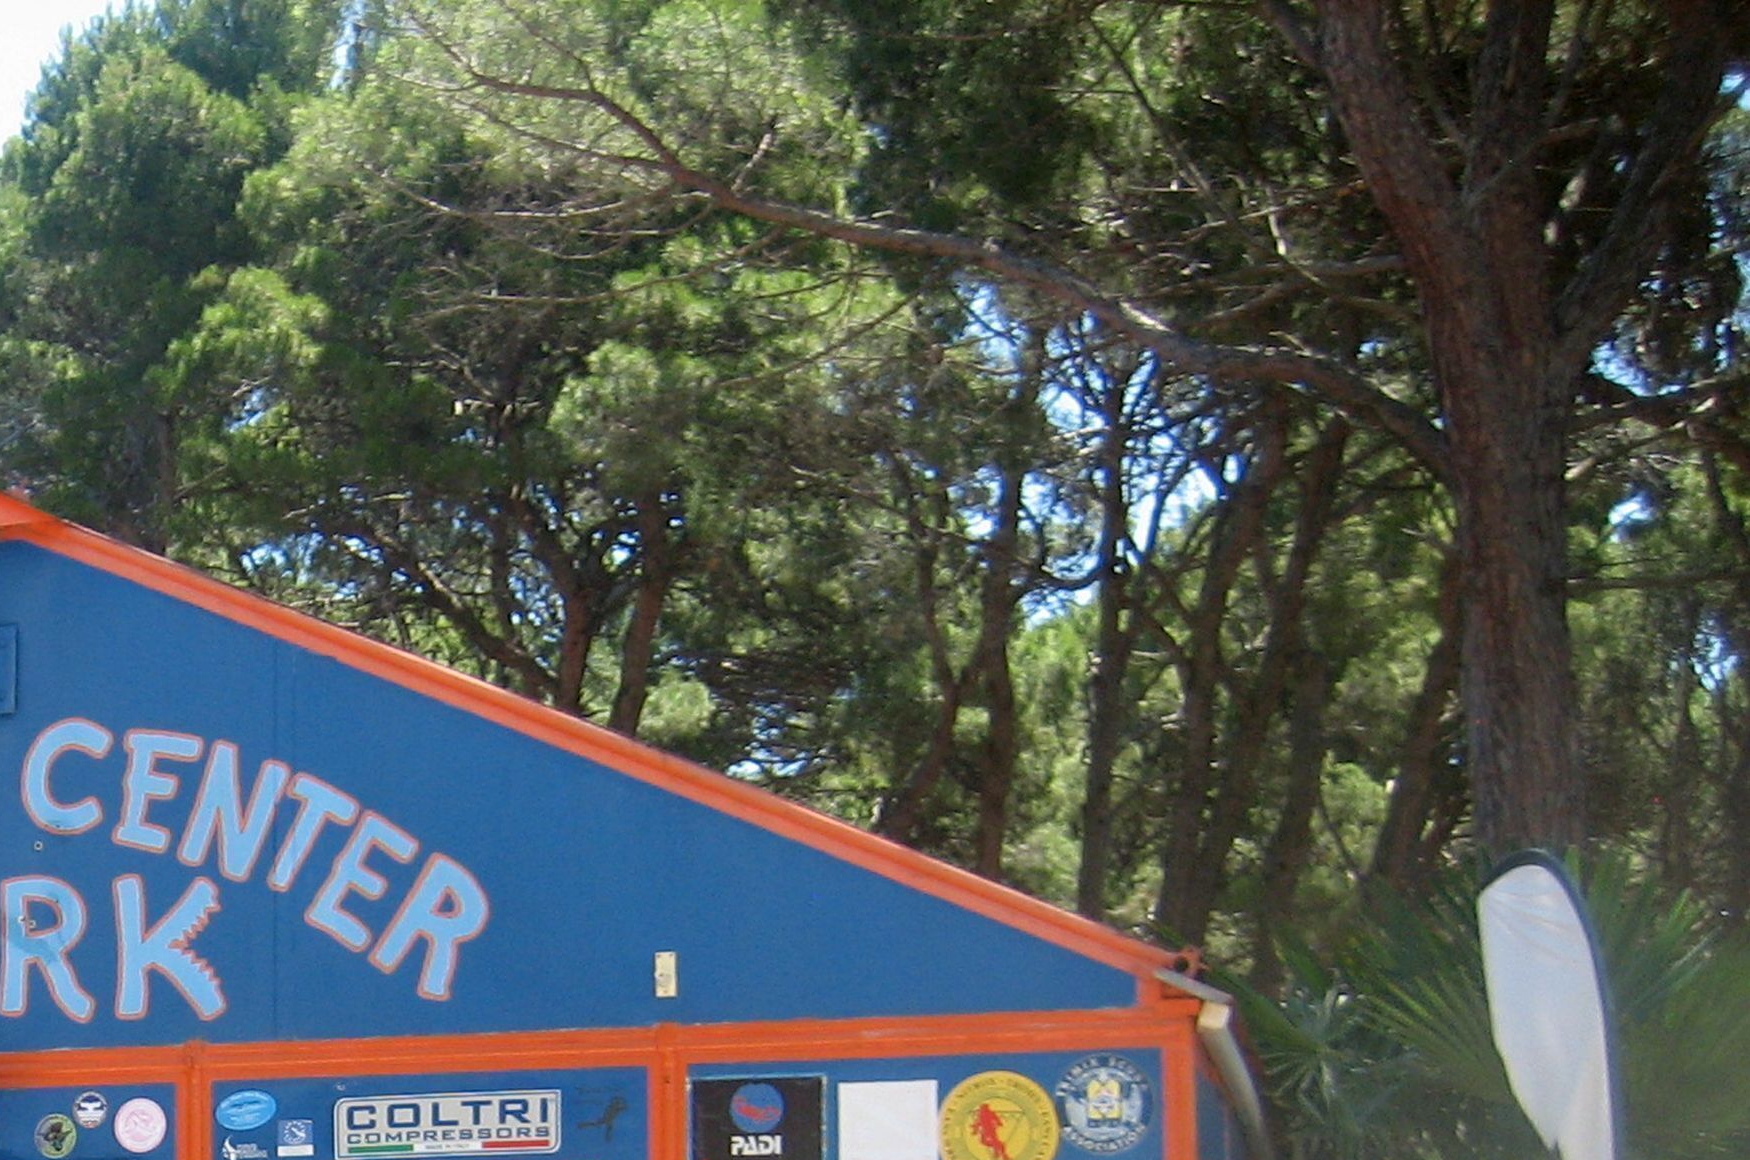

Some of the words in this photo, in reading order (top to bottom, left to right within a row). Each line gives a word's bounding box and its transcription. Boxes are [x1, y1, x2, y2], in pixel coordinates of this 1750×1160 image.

[22, 718, 491, 1001] CENTER
[346, 1098, 548, 1130] COLTRI
[346, 1126, 550, 1144] COMPRESSORS
[730, 1135, 783, 1156] PADI
